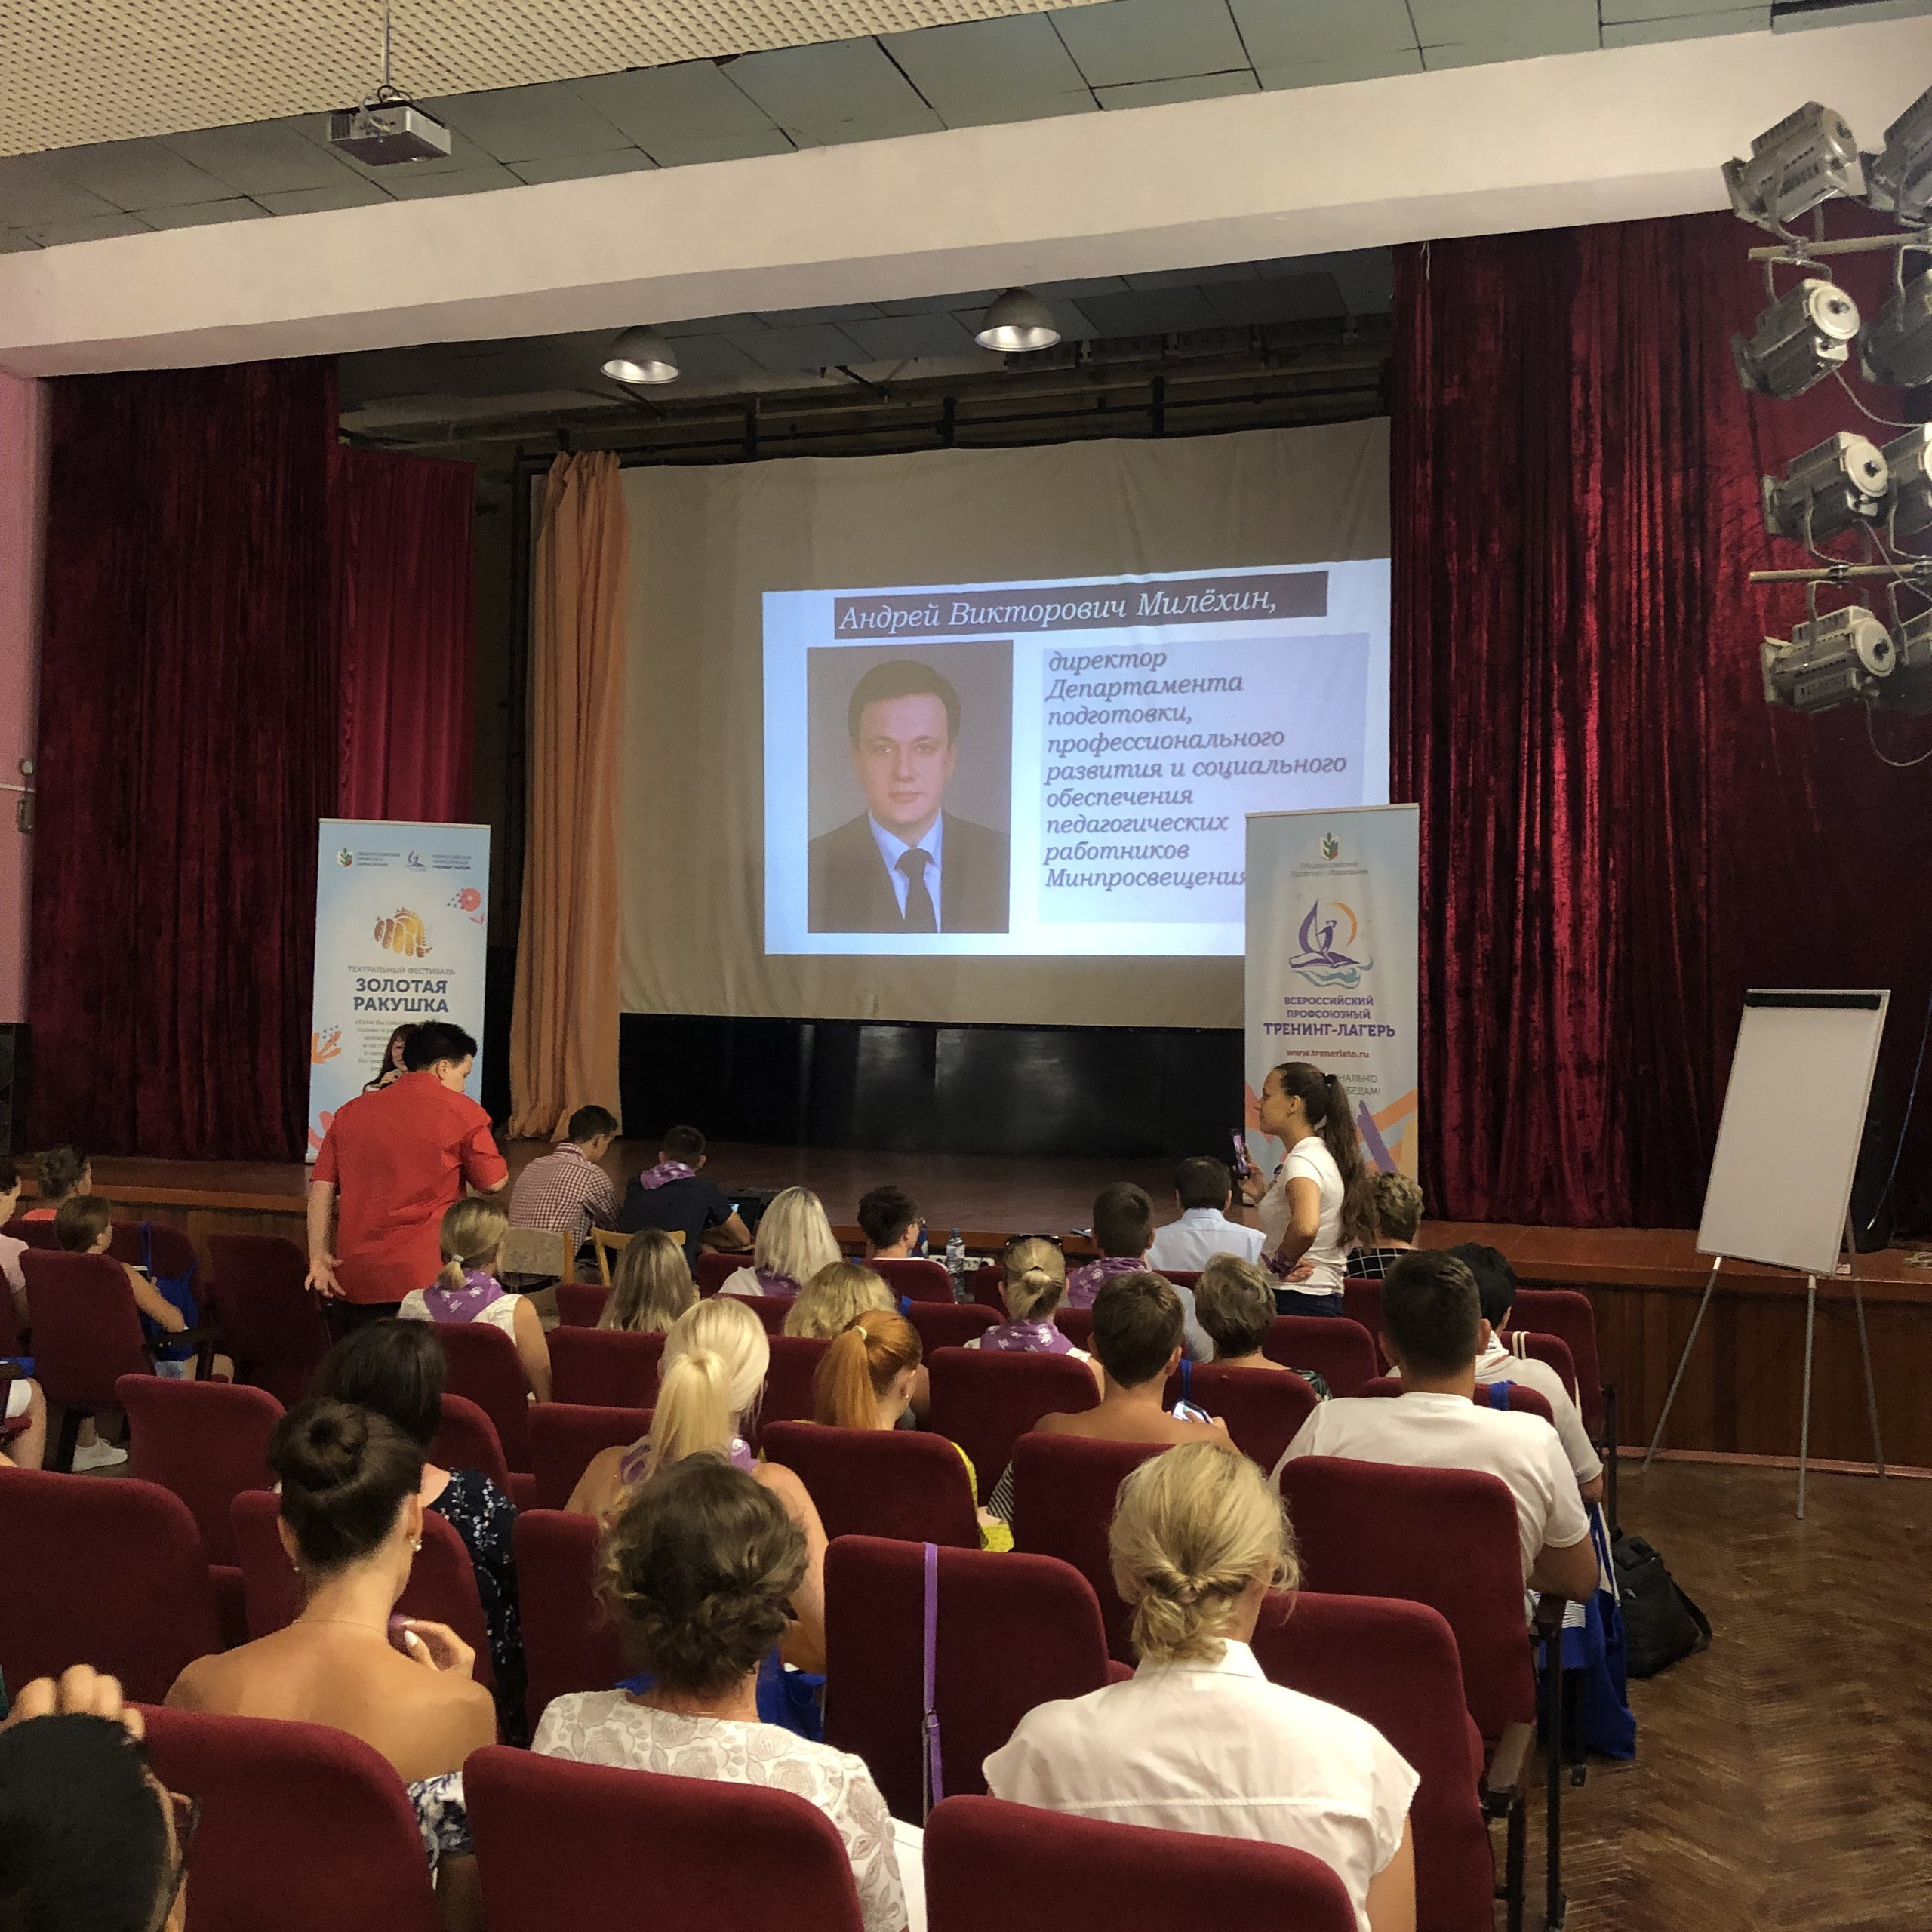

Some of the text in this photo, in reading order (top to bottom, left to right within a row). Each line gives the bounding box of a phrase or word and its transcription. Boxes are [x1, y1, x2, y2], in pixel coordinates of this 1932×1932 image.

[838, 589, 1276, 634] Андрей Викторович Милёхин,
[1048, 651, 1168, 675] директор
[1044, 675, 1244, 702] Департамента
[1048, 705, 1192, 726] подготовки,
[1048, 731, 1285, 758] профессионального
[1044, 756, 1347, 786] развития и социального
[1046, 787, 1194, 808] обеспечения
[1046, 813, 1229, 834] педагогических
[1043, 841, 1190, 865] работников
[347, 965, 456, 975] ТЕАТРАЛЬНЫЙ ФЕСТИВАЛЬ
[355, 977, 448, 994] ЗОЛОТАЯ
[353, 996, 449, 1013] РАКУШКА
[1284, 995, 1374, 1006] ВСЕРОССИЙСКИЙ
[1287, 1008, 1371, 1019] ПРОФСОЮЗНЫЙ
[1263, 1023, 1396, 1038] ТРЕНИНГ-ЛАГЕРЬ
[1287, 1049, 1370, 1058] www.trenerleto.ru
[1346, 1086, 1381, 1095] БЕДАМ!
